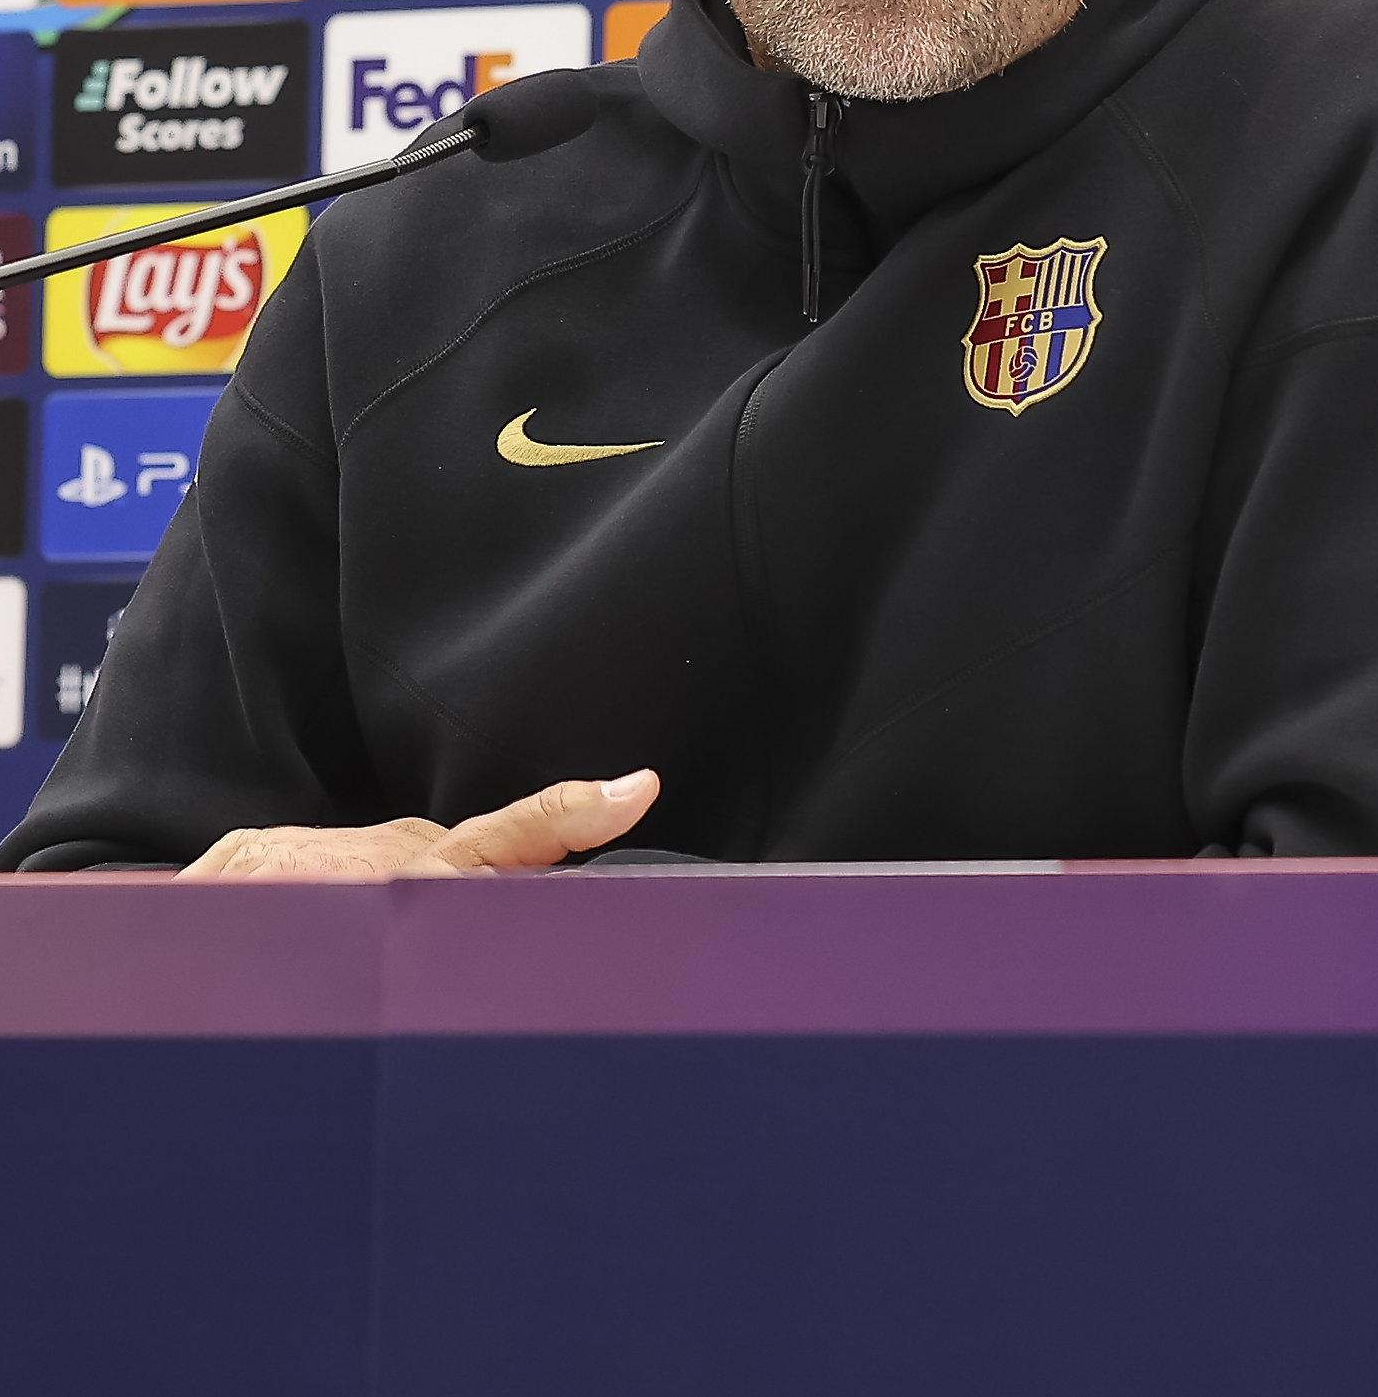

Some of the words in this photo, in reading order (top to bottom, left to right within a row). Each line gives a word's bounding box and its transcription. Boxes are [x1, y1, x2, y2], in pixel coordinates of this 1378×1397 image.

[104, 56, 289, 111] Follow
[352, 53, 512, 130] FedE
[116, 112, 245, 153] Scores
[93, 235, 260, 348] Lay's
[1004, 311, 1054, 336] FCB
